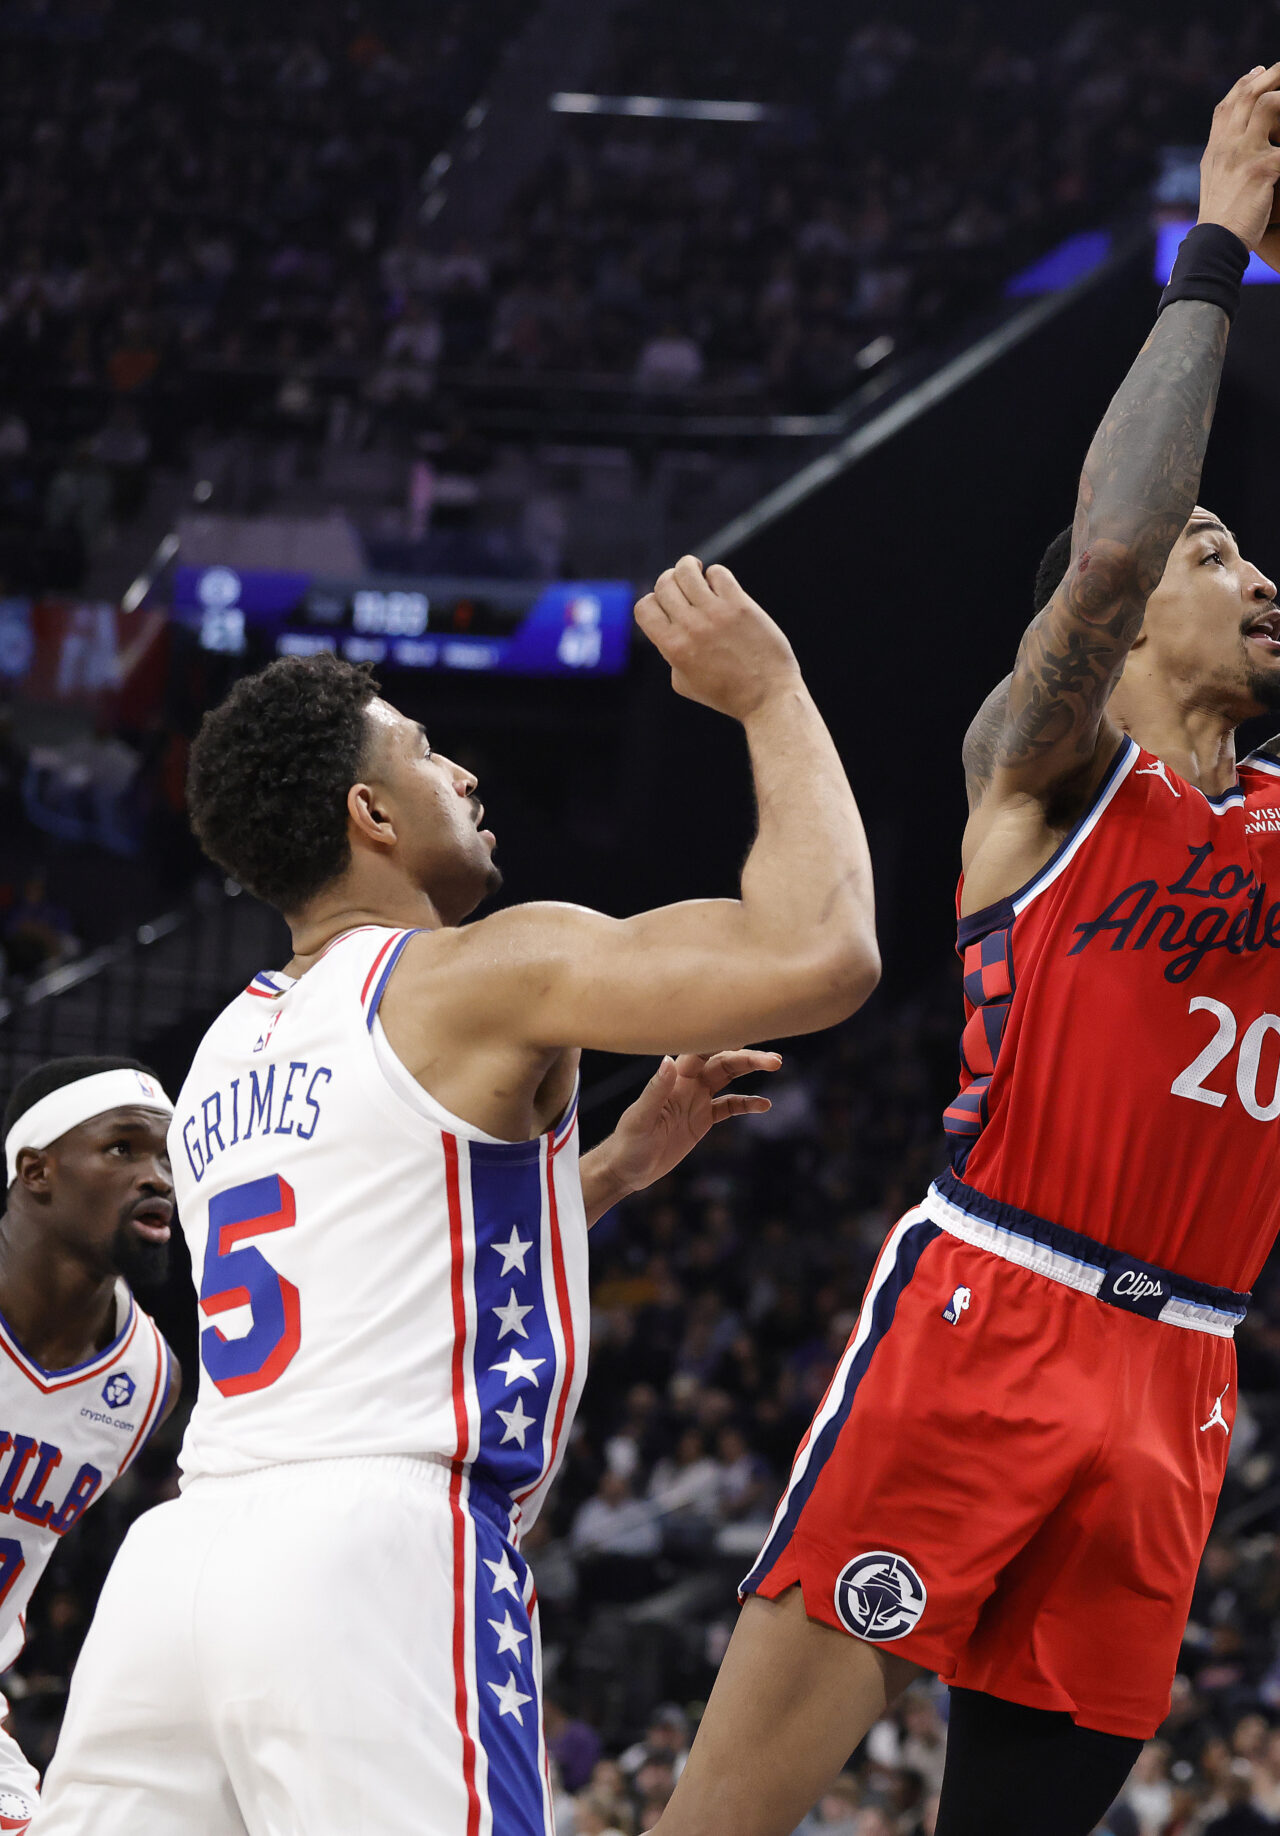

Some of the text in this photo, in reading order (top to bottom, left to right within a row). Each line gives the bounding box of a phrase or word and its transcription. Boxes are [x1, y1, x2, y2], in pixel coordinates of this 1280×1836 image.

[182, 1061, 333, 1183] GRIMES
[198, 1173, 301, 1398] 5
[1112, 1270, 1164, 1302] Clips
[79, 1407, 135, 1432] crypto.com
[0, 1429, 103, 1537] ILA
